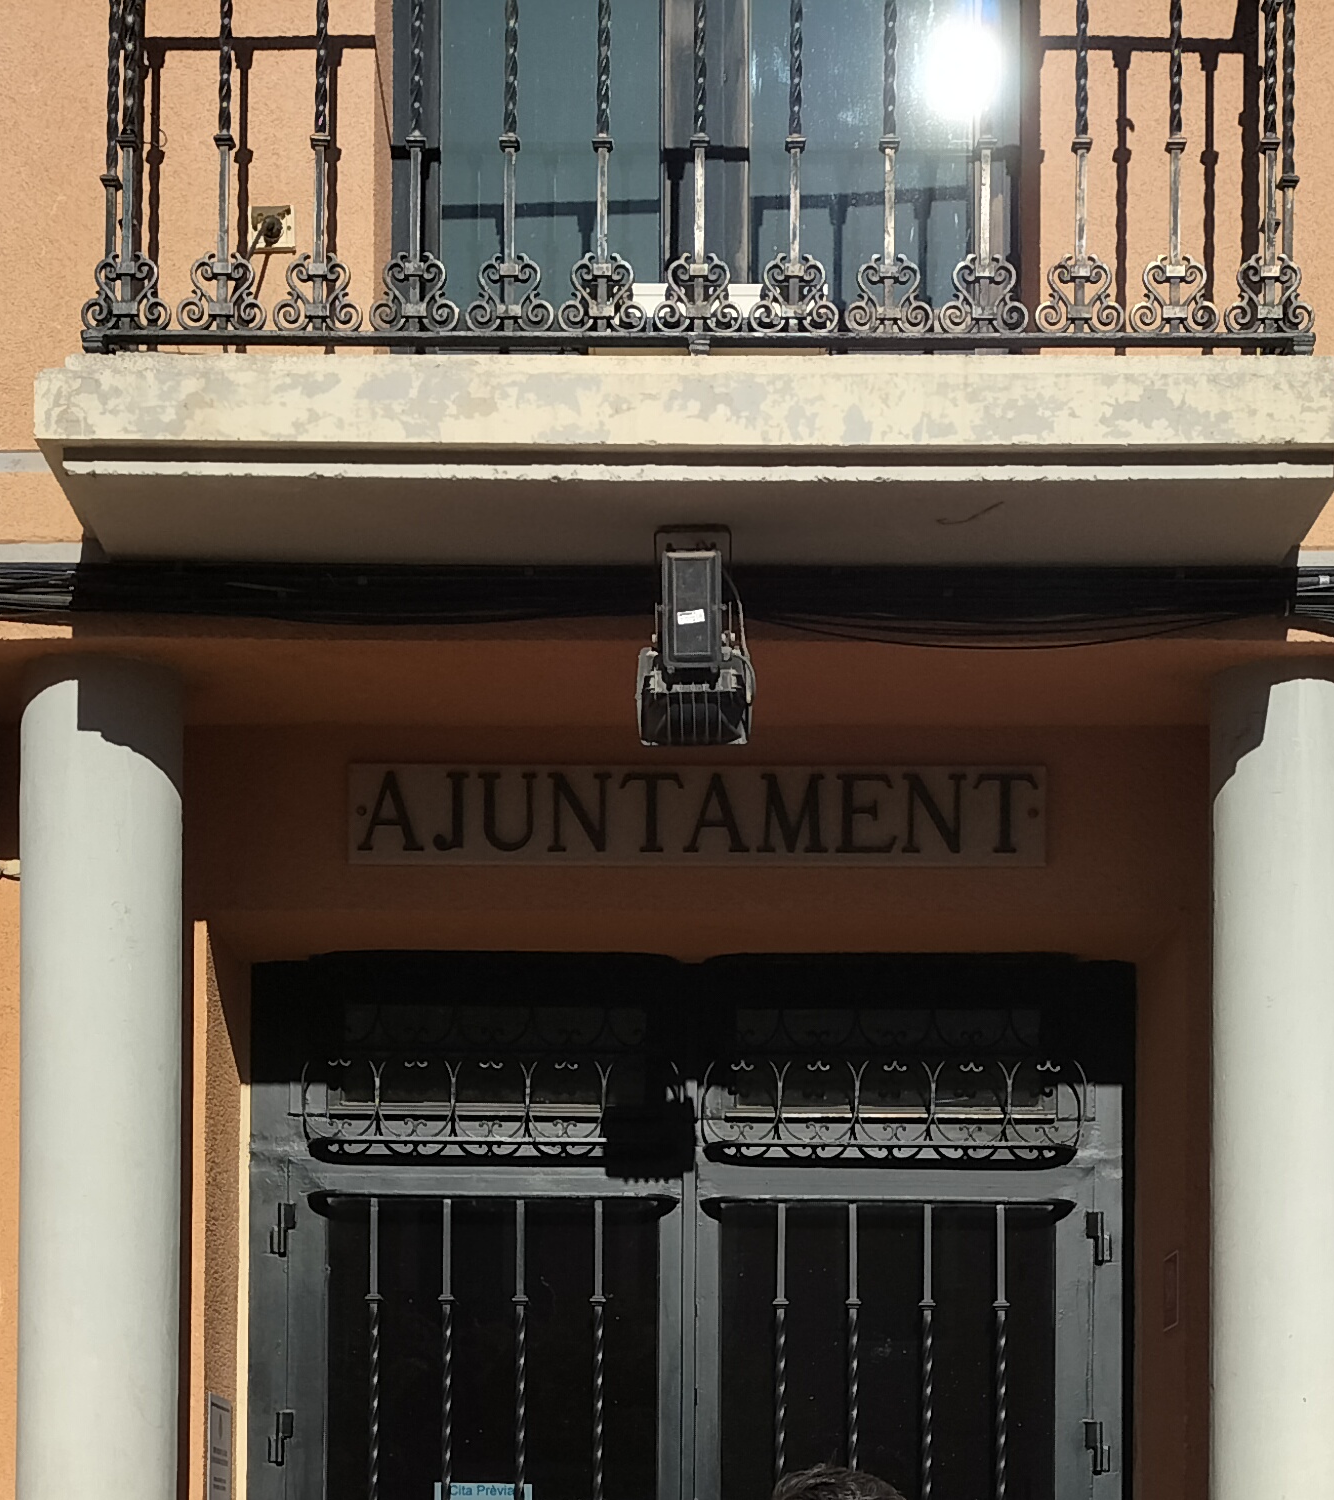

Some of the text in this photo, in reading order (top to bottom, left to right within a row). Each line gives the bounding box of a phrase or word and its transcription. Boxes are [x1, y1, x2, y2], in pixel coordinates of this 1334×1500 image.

[357, 772, 1038, 853] AJUNTAMENT
[450, 1484, 514, 1496] Cita Prèvia
